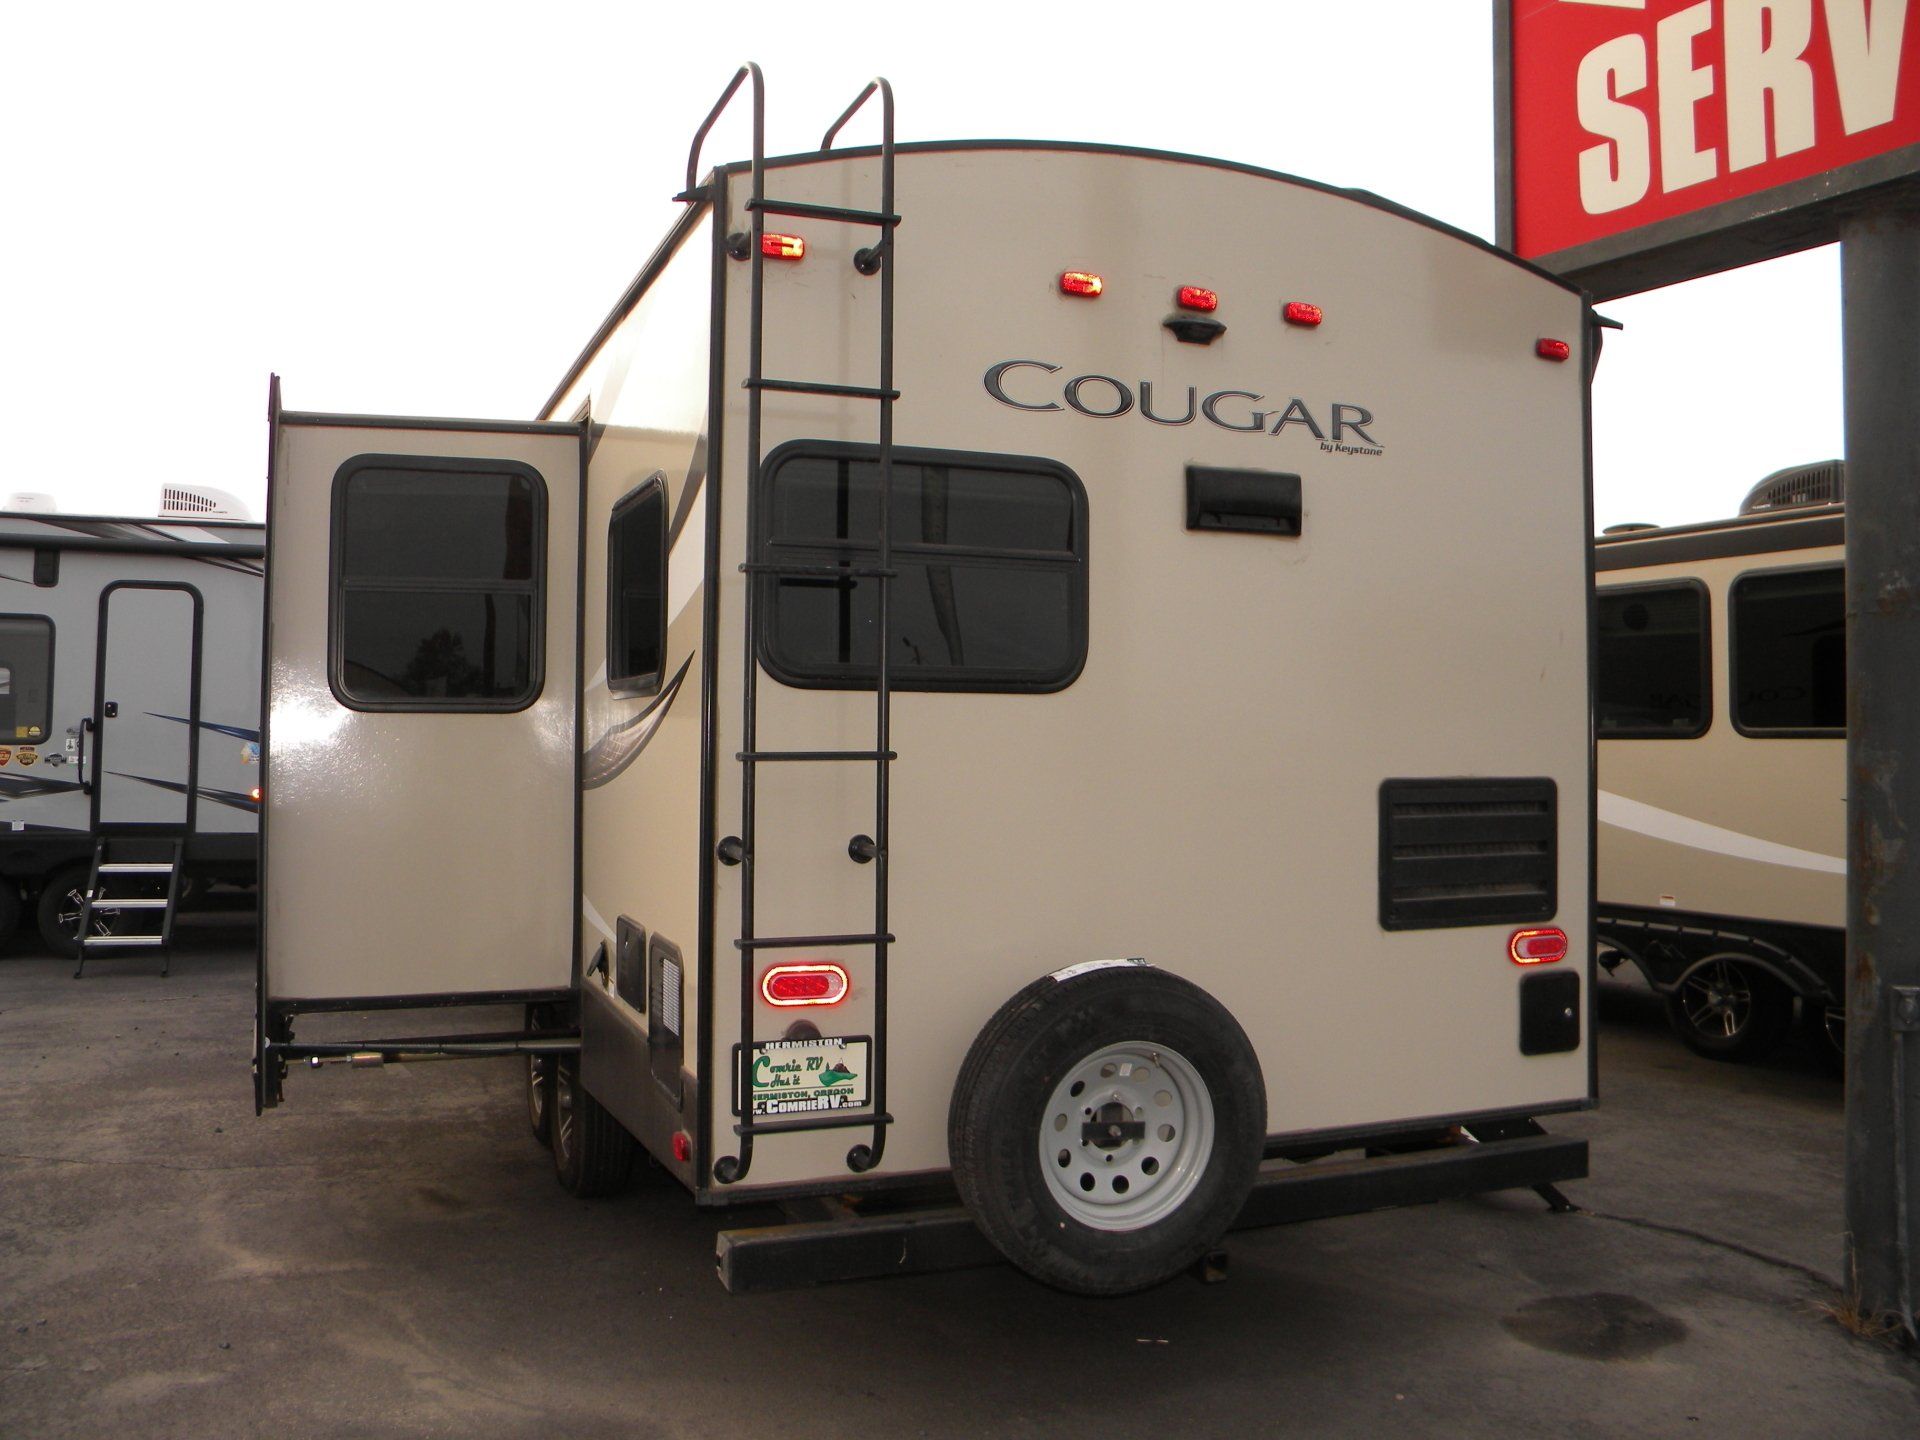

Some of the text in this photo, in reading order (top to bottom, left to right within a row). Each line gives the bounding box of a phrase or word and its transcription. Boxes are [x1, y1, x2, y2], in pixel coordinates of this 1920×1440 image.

[1320, 441, 1383, 456] by Keystone
[766, 1038, 843, 1050] HERMISTON
[752, 1055, 823, 1088] Comrie RV
[770, 1074, 801, 1088] Has it
[814, 1087, 854, 1099] OREGON
